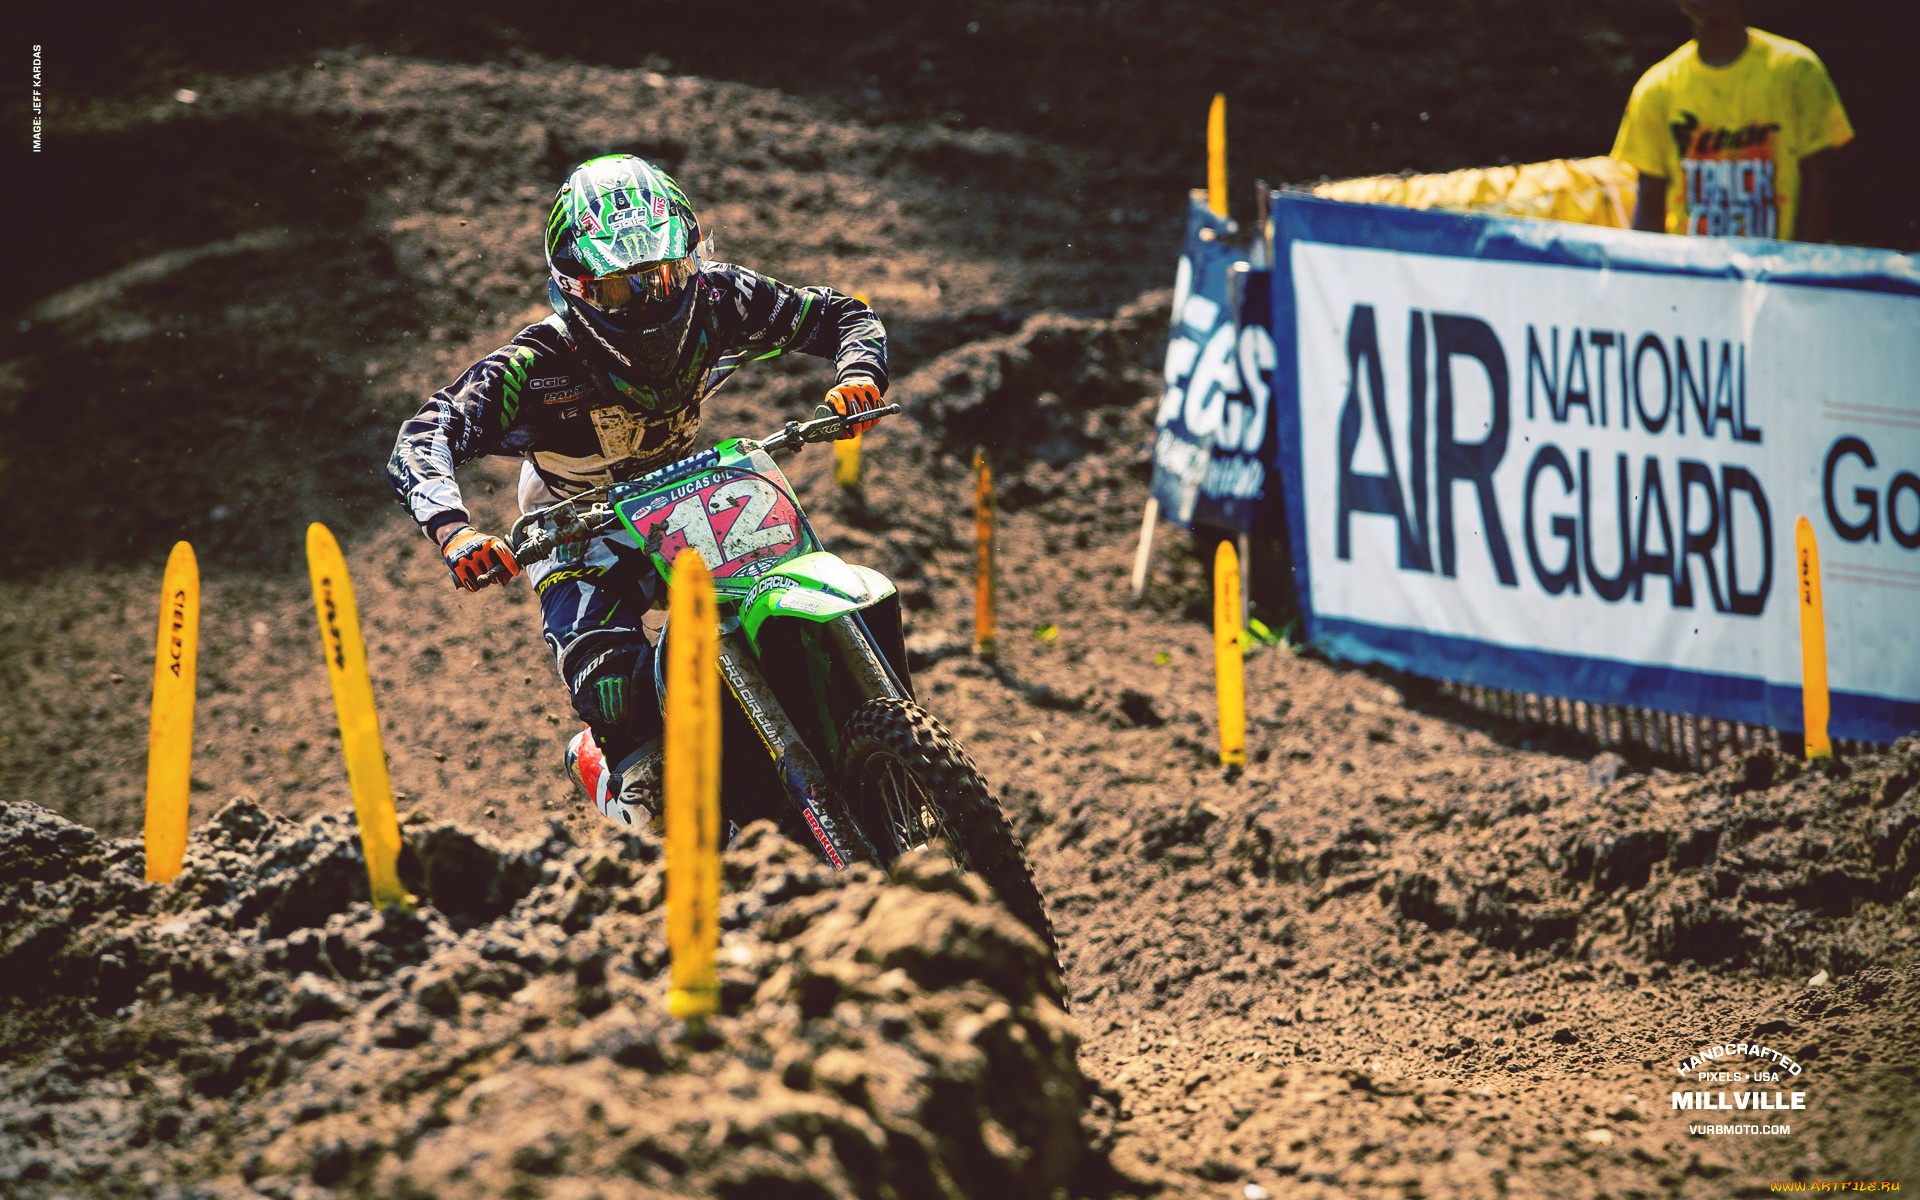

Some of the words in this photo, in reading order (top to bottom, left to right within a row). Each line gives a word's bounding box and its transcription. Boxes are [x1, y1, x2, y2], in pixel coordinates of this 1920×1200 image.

[653, 195, 666, 219] VANS
[529, 375, 570, 390] OGIO
[398, 436, 413, 489] MONST
[1336, 302, 1519, 587] AIR
[1526, 323, 1763, 444] NATIONAL
[670, 473, 710, 501] LUCAS
[712, 471, 733, 485] OIL
[664, 478, 796, 572] 12
[1523, 442, 1775, 617] GUARD
[758, 575, 801, 594] CIRCUIT
[574, 648, 613, 695] thor
[718, 653, 745, 689] PRO
[739, 686, 785, 748] CIRCUIT
[803, 807, 845, 871] BRAKING
